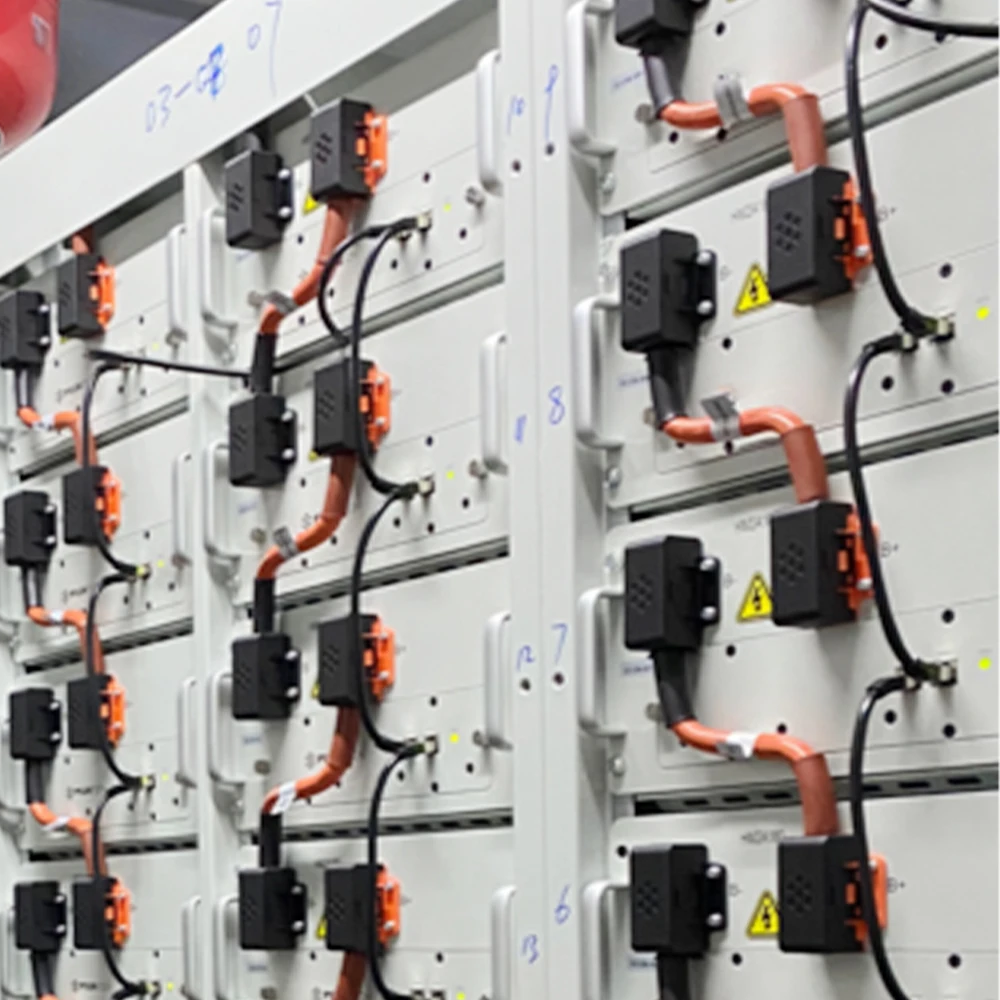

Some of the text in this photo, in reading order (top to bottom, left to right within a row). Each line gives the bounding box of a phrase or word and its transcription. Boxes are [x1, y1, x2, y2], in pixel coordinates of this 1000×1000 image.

[548, 384, 566, 425] 8
[551, 622, 568, 665] 7
[554, 884, 571, 925] 6
